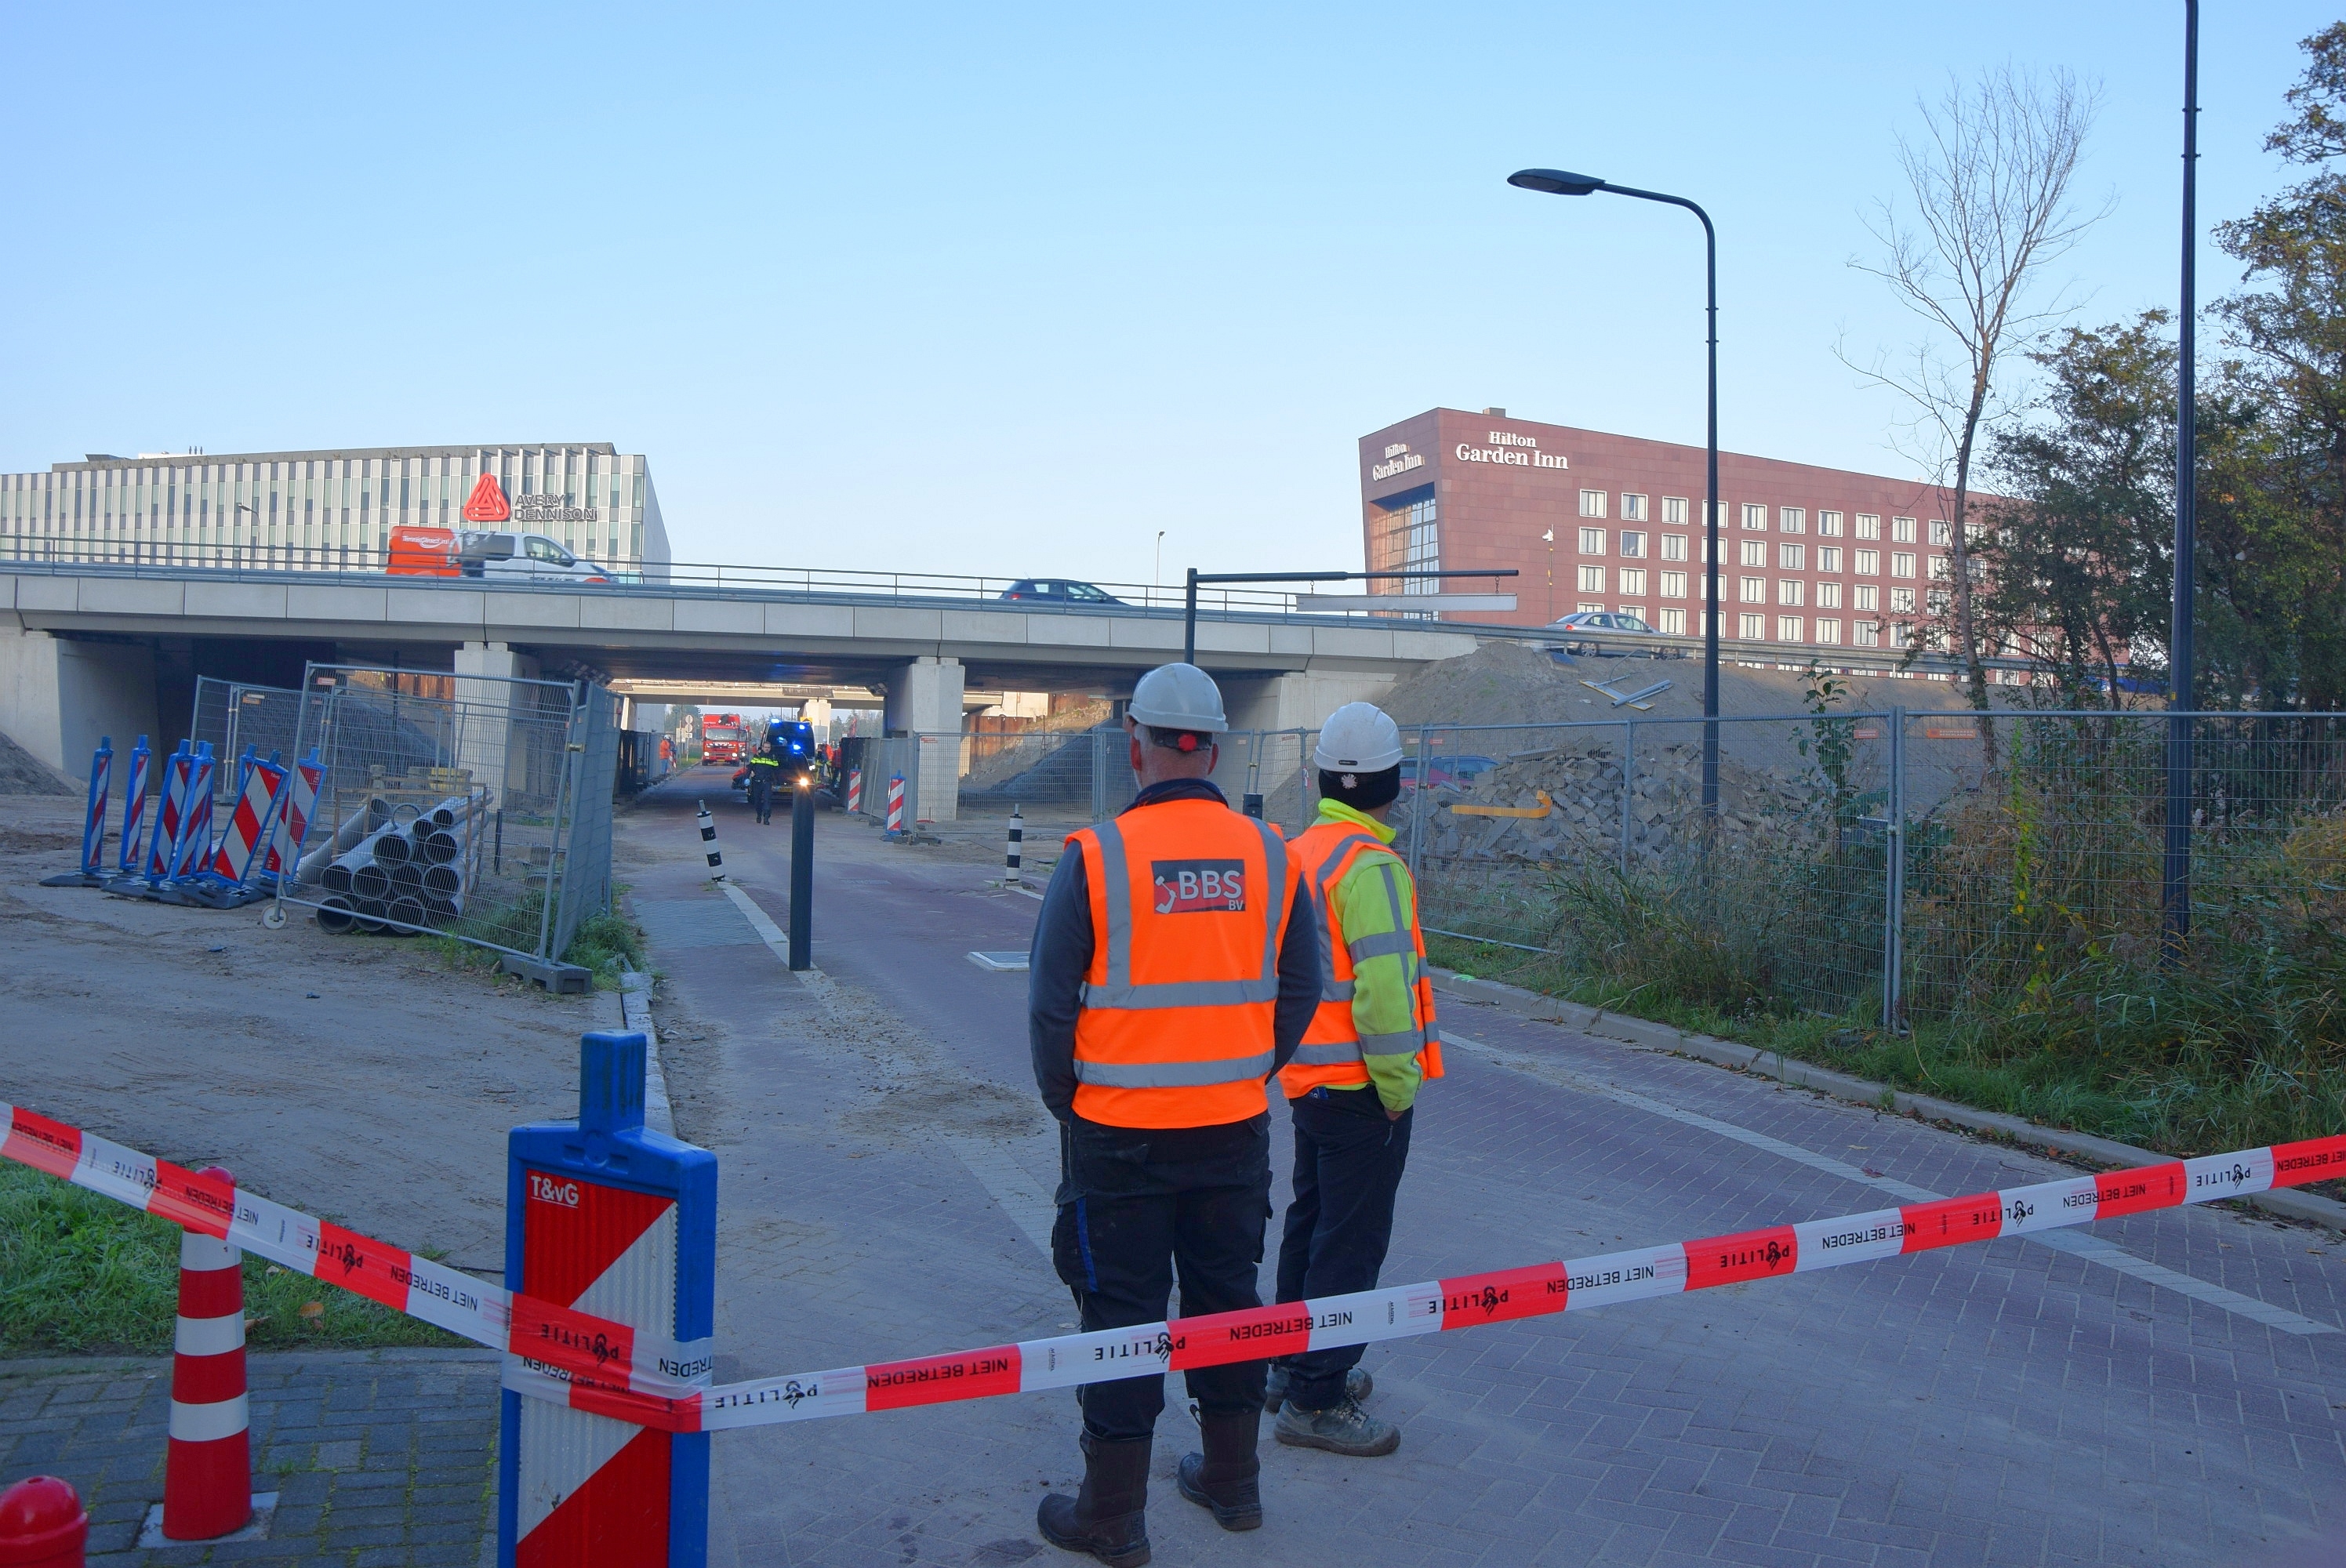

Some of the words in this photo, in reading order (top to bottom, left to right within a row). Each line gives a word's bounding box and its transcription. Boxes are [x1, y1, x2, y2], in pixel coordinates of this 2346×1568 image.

[1489, 431, 1537, 448] Hilton
[1385, 443, 1409, 459] Hilton
[1455, 444, 1529, 466] Garden
[1532, 449, 1569, 470] Inn
[1373, 457, 1404, 481] Garden
[1404, 453, 1425, 471] Inn
[515, 494, 566, 507] AVERY
[514, 508, 597, 521] DENNISON
[1178, 870, 1242, 900] BBS
[1229, 899, 1244, 911] BV
[2277, 1153, 2328, 1172] BETREDEN
[530, 1175, 579, 1206] T&vG
[2063, 1188, 2121, 1208] BETREDEN
[2123, 1183, 2146, 1198] NIET
[186, 1186, 234, 1216] BETREDEN
[237, 1207, 260, 1225] NIET
[1821, 1227, 1887, 1250] BETREDEN
[1889, 1221, 1916, 1239] NIET
[390, 1265, 449, 1301] BETREDEN
[1547, 1272, 1620, 1294] BETREDEN
[1624, 1265, 1654, 1282] NIET
[452, 1290, 478, 1312] NIET
[1229, 1317, 1313, 1341] BETREDEN
[1319, 1311, 1353, 1328] NIET
[867, 1364, 964, 1388] BETREDEN
[969, 1359, 1008, 1376] NIET
